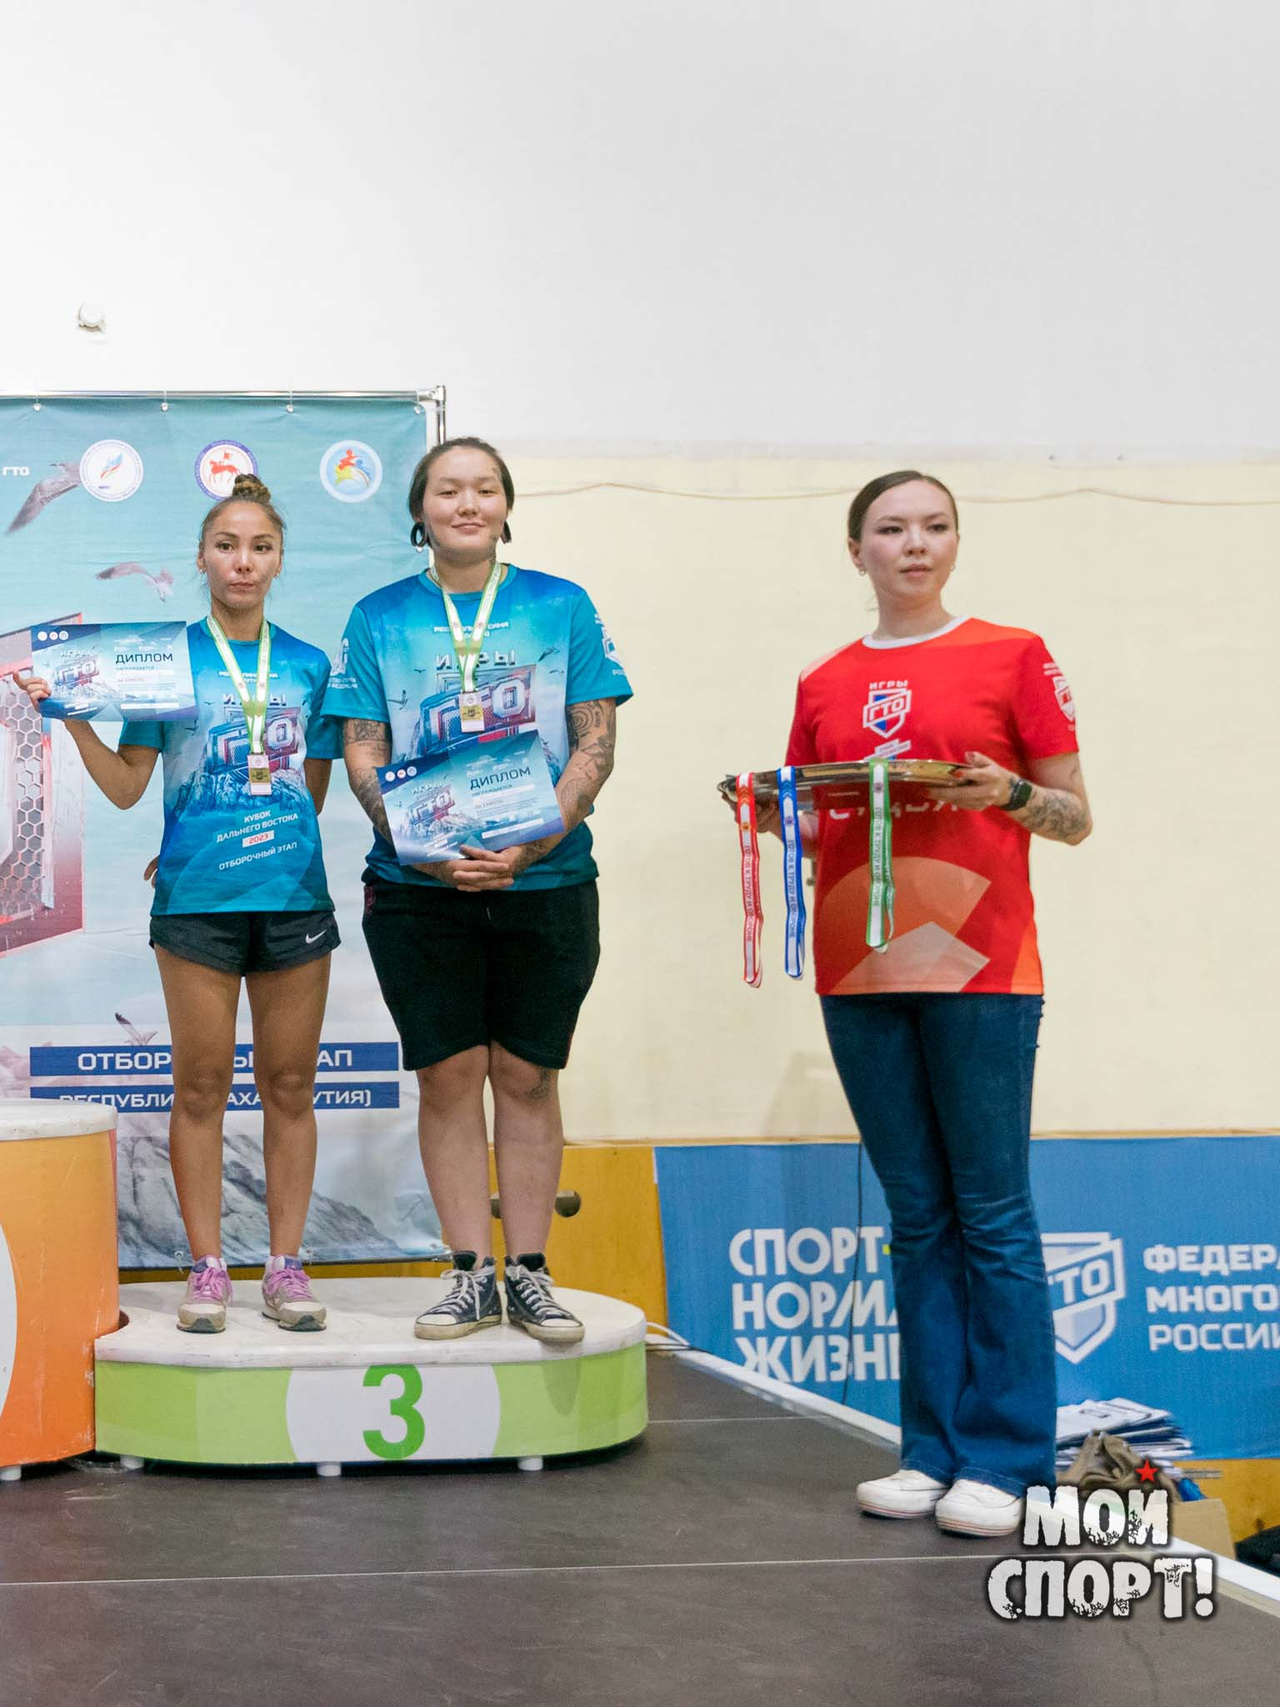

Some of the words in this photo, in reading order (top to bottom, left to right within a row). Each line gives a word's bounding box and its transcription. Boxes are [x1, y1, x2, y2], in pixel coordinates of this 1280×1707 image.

[2, 466, 30, 476] ГТО
[116, 652, 174, 665] ДИПЛОМ
[869, 680, 908, 690] ИГРЫ
[869, 697, 905, 721] ГТО
[470, 767, 531, 791] ДИПЛОМ
[216, 823, 261, 843] ДАЛЬНЕГО
[261, 813, 299, 829] ВОСТОКА
[244, 810, 272, 823] КУБОК
[248, 833, 269, 844] 2023
[219, 847, 276, 871] ОТБОРОЧНЫЙ
[277, 841, 298, 853] ЭТАП
[223, 1091, 261, 1106] АХА
[1143, 1244, 1280, 1276] ФЕДЕР
[1048, 1259, 1110, 1305] ТО
[731, 1280, 898, 1331] НОРМ
[362, 1364, 426, 1460] 3
